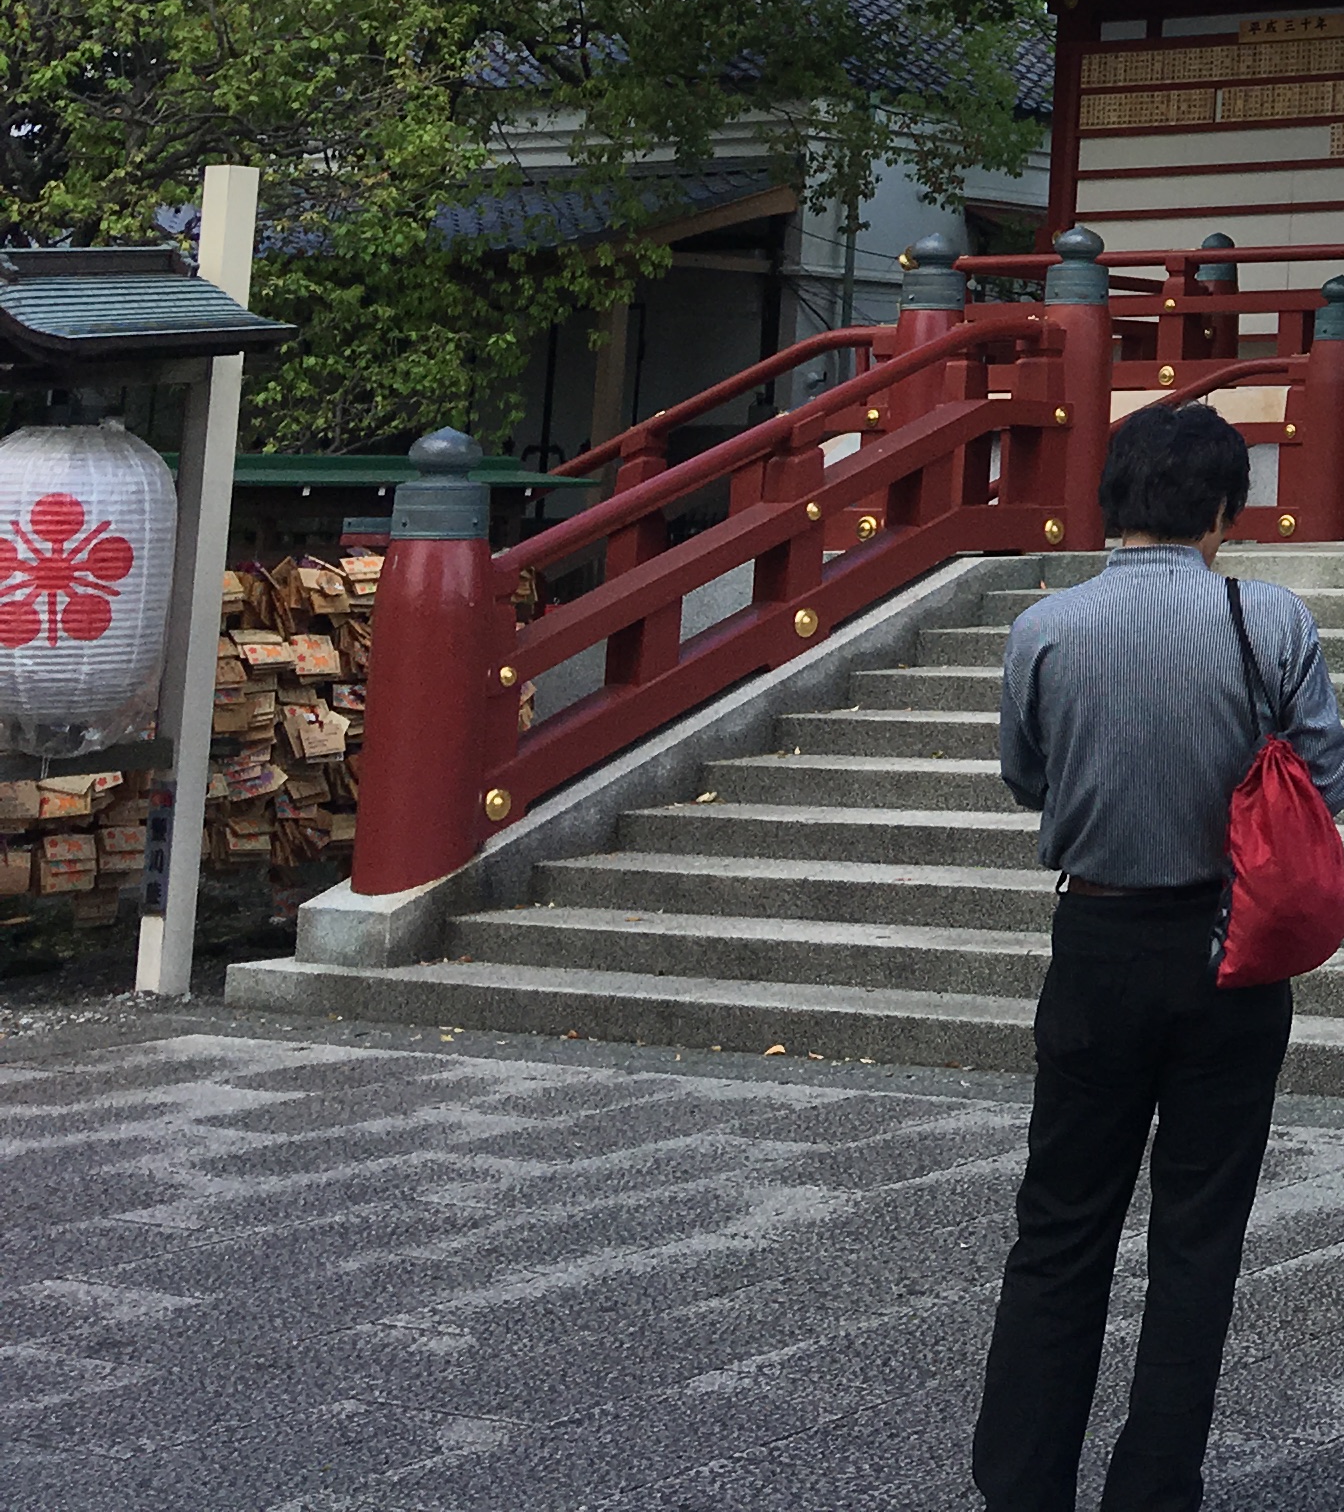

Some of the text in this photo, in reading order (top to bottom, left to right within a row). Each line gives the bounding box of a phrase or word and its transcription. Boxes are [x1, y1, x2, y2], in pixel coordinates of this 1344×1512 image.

[1248, 17, 1327, 36] 平成三十年
